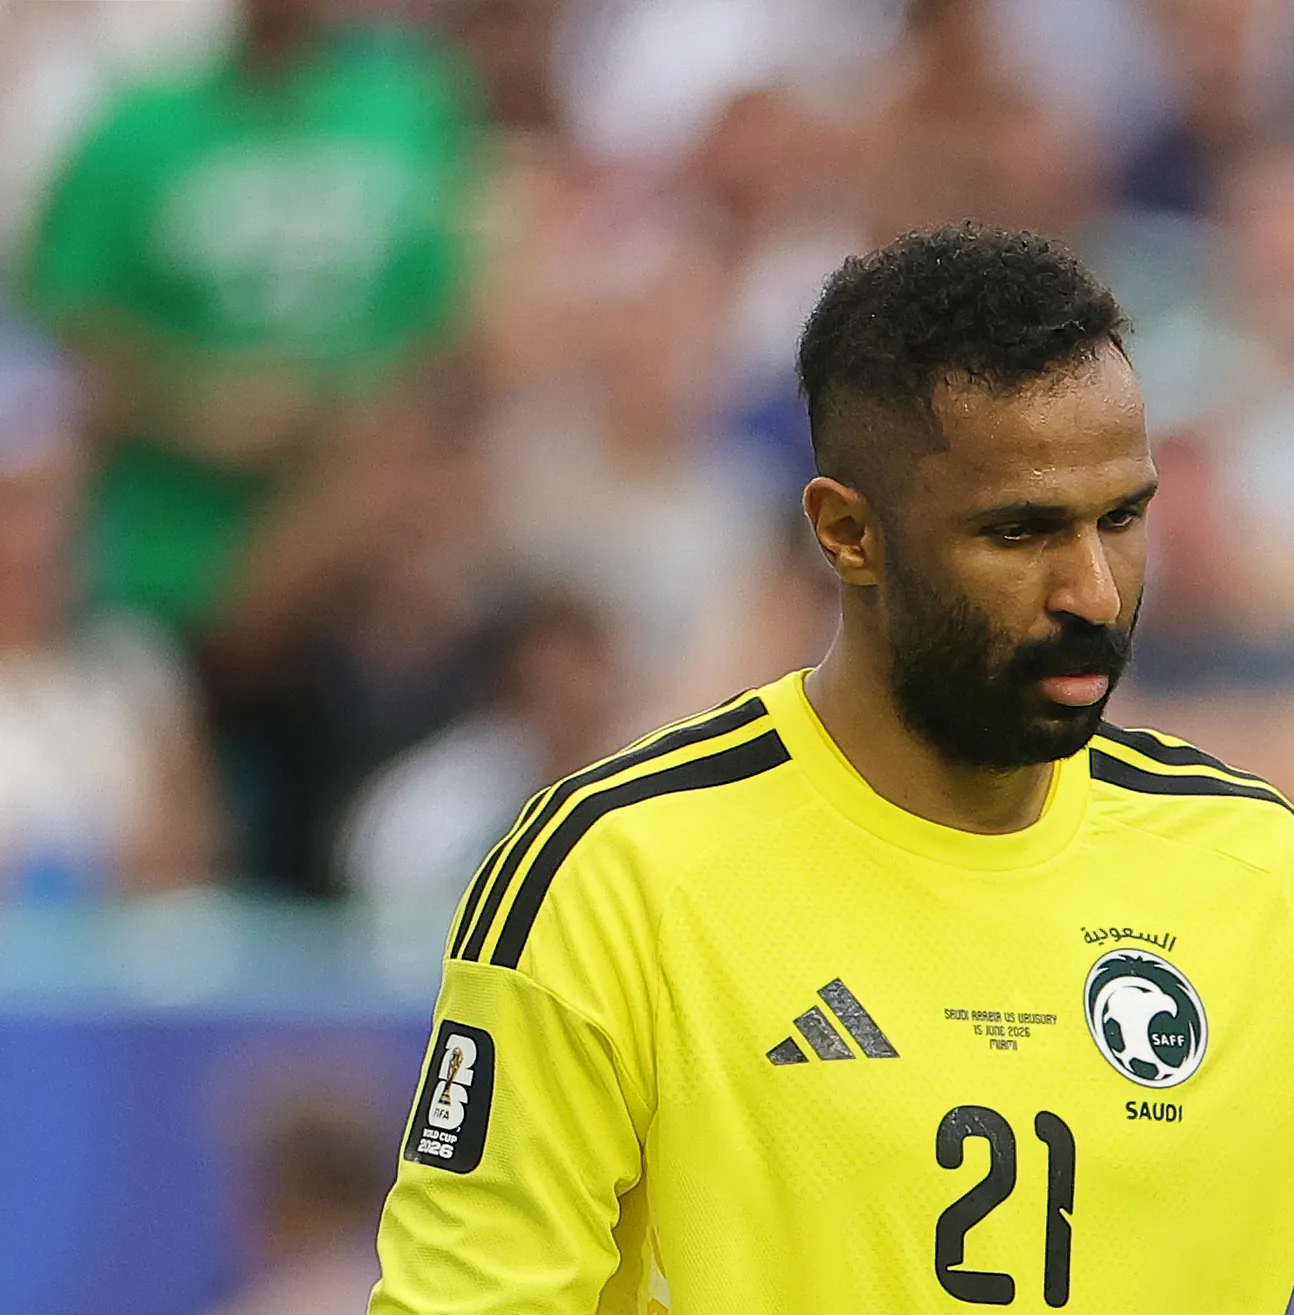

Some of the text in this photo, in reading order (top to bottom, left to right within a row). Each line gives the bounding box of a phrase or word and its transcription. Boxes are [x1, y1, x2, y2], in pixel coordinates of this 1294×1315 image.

[1080, 926, 1177, 952] السعودية
[973, 1024, 1031, 1037] 15 JUNE 2026
[1152, 1032, 1185, 1047] SAFF
[1126, 1102, 1183, 1123] SAUDI
[417, 1138, 454, 1159] 2026
[439, 1132, 458, 1144] CUP
[935, 1105, 1075, 1308] 21
